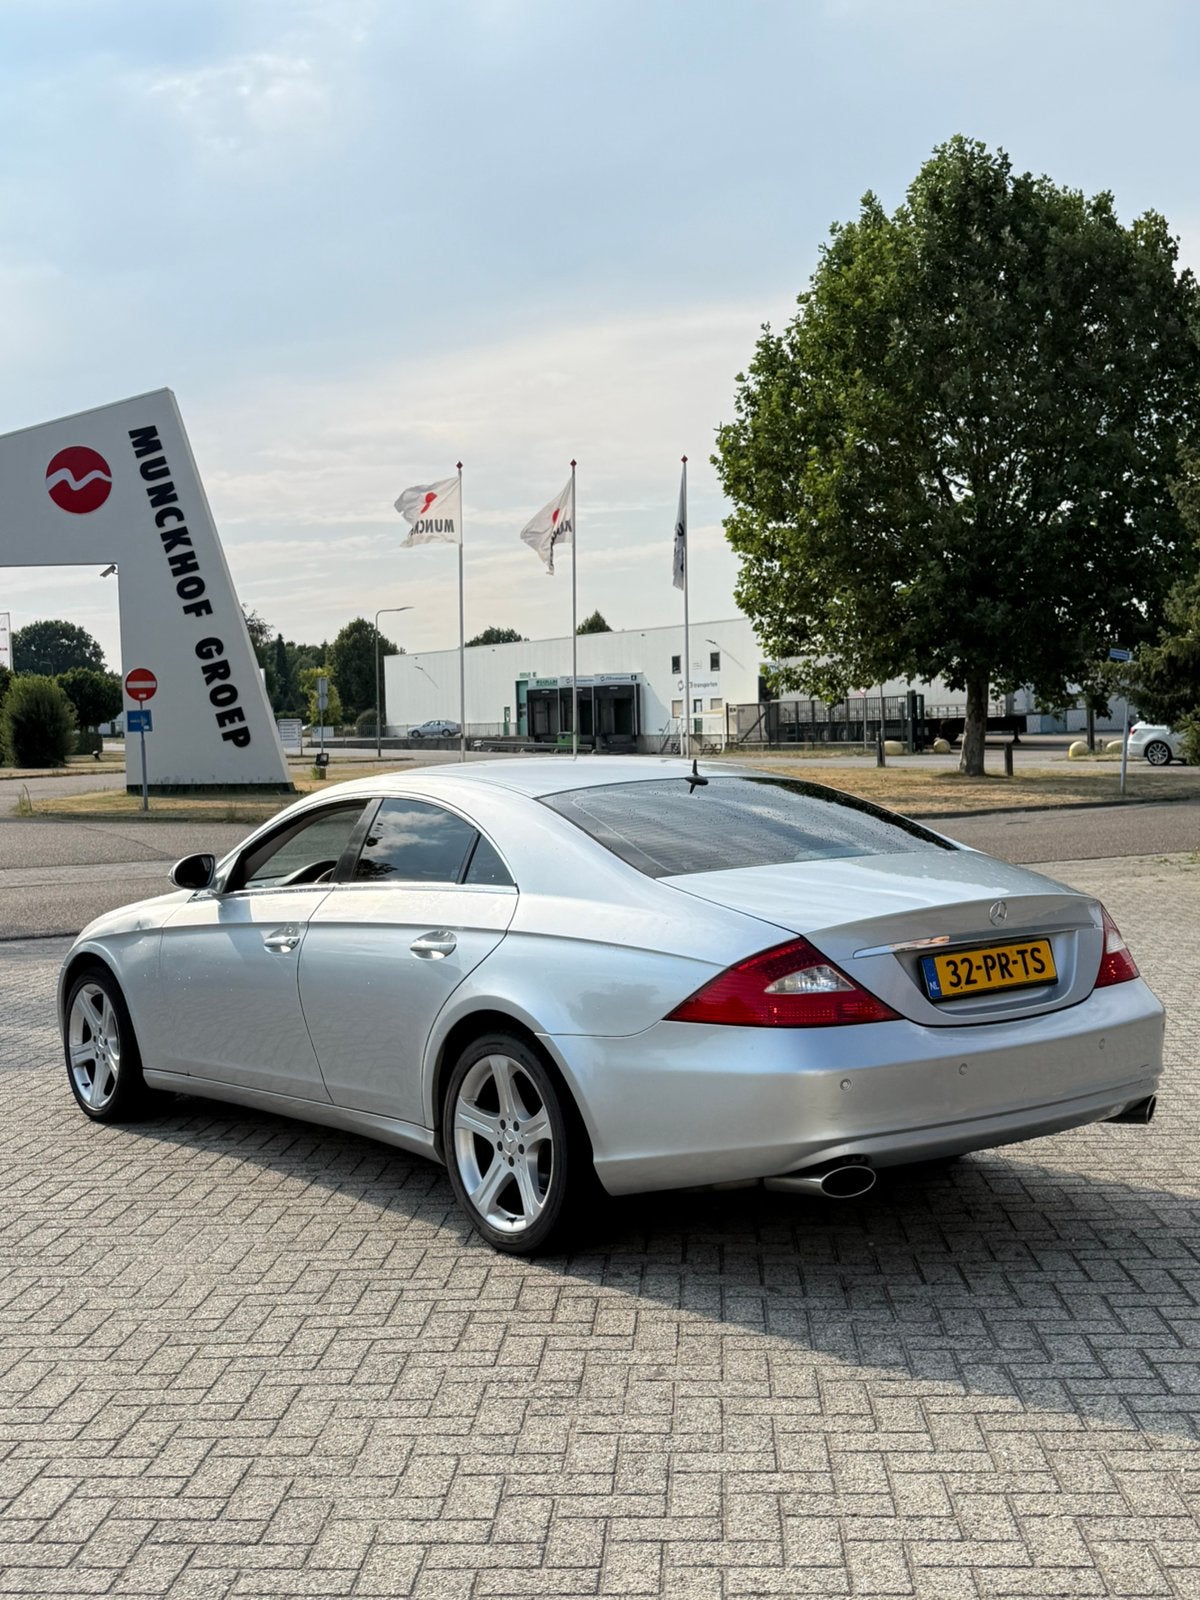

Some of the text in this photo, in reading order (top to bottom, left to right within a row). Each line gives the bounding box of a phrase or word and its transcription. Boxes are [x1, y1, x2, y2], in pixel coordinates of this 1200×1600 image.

[128, 424, 251, 749] MUNCKHOF GROEP
[930, 982, 940, 990] NL
[946, 947, 1046, 987] 32-PR-TS
